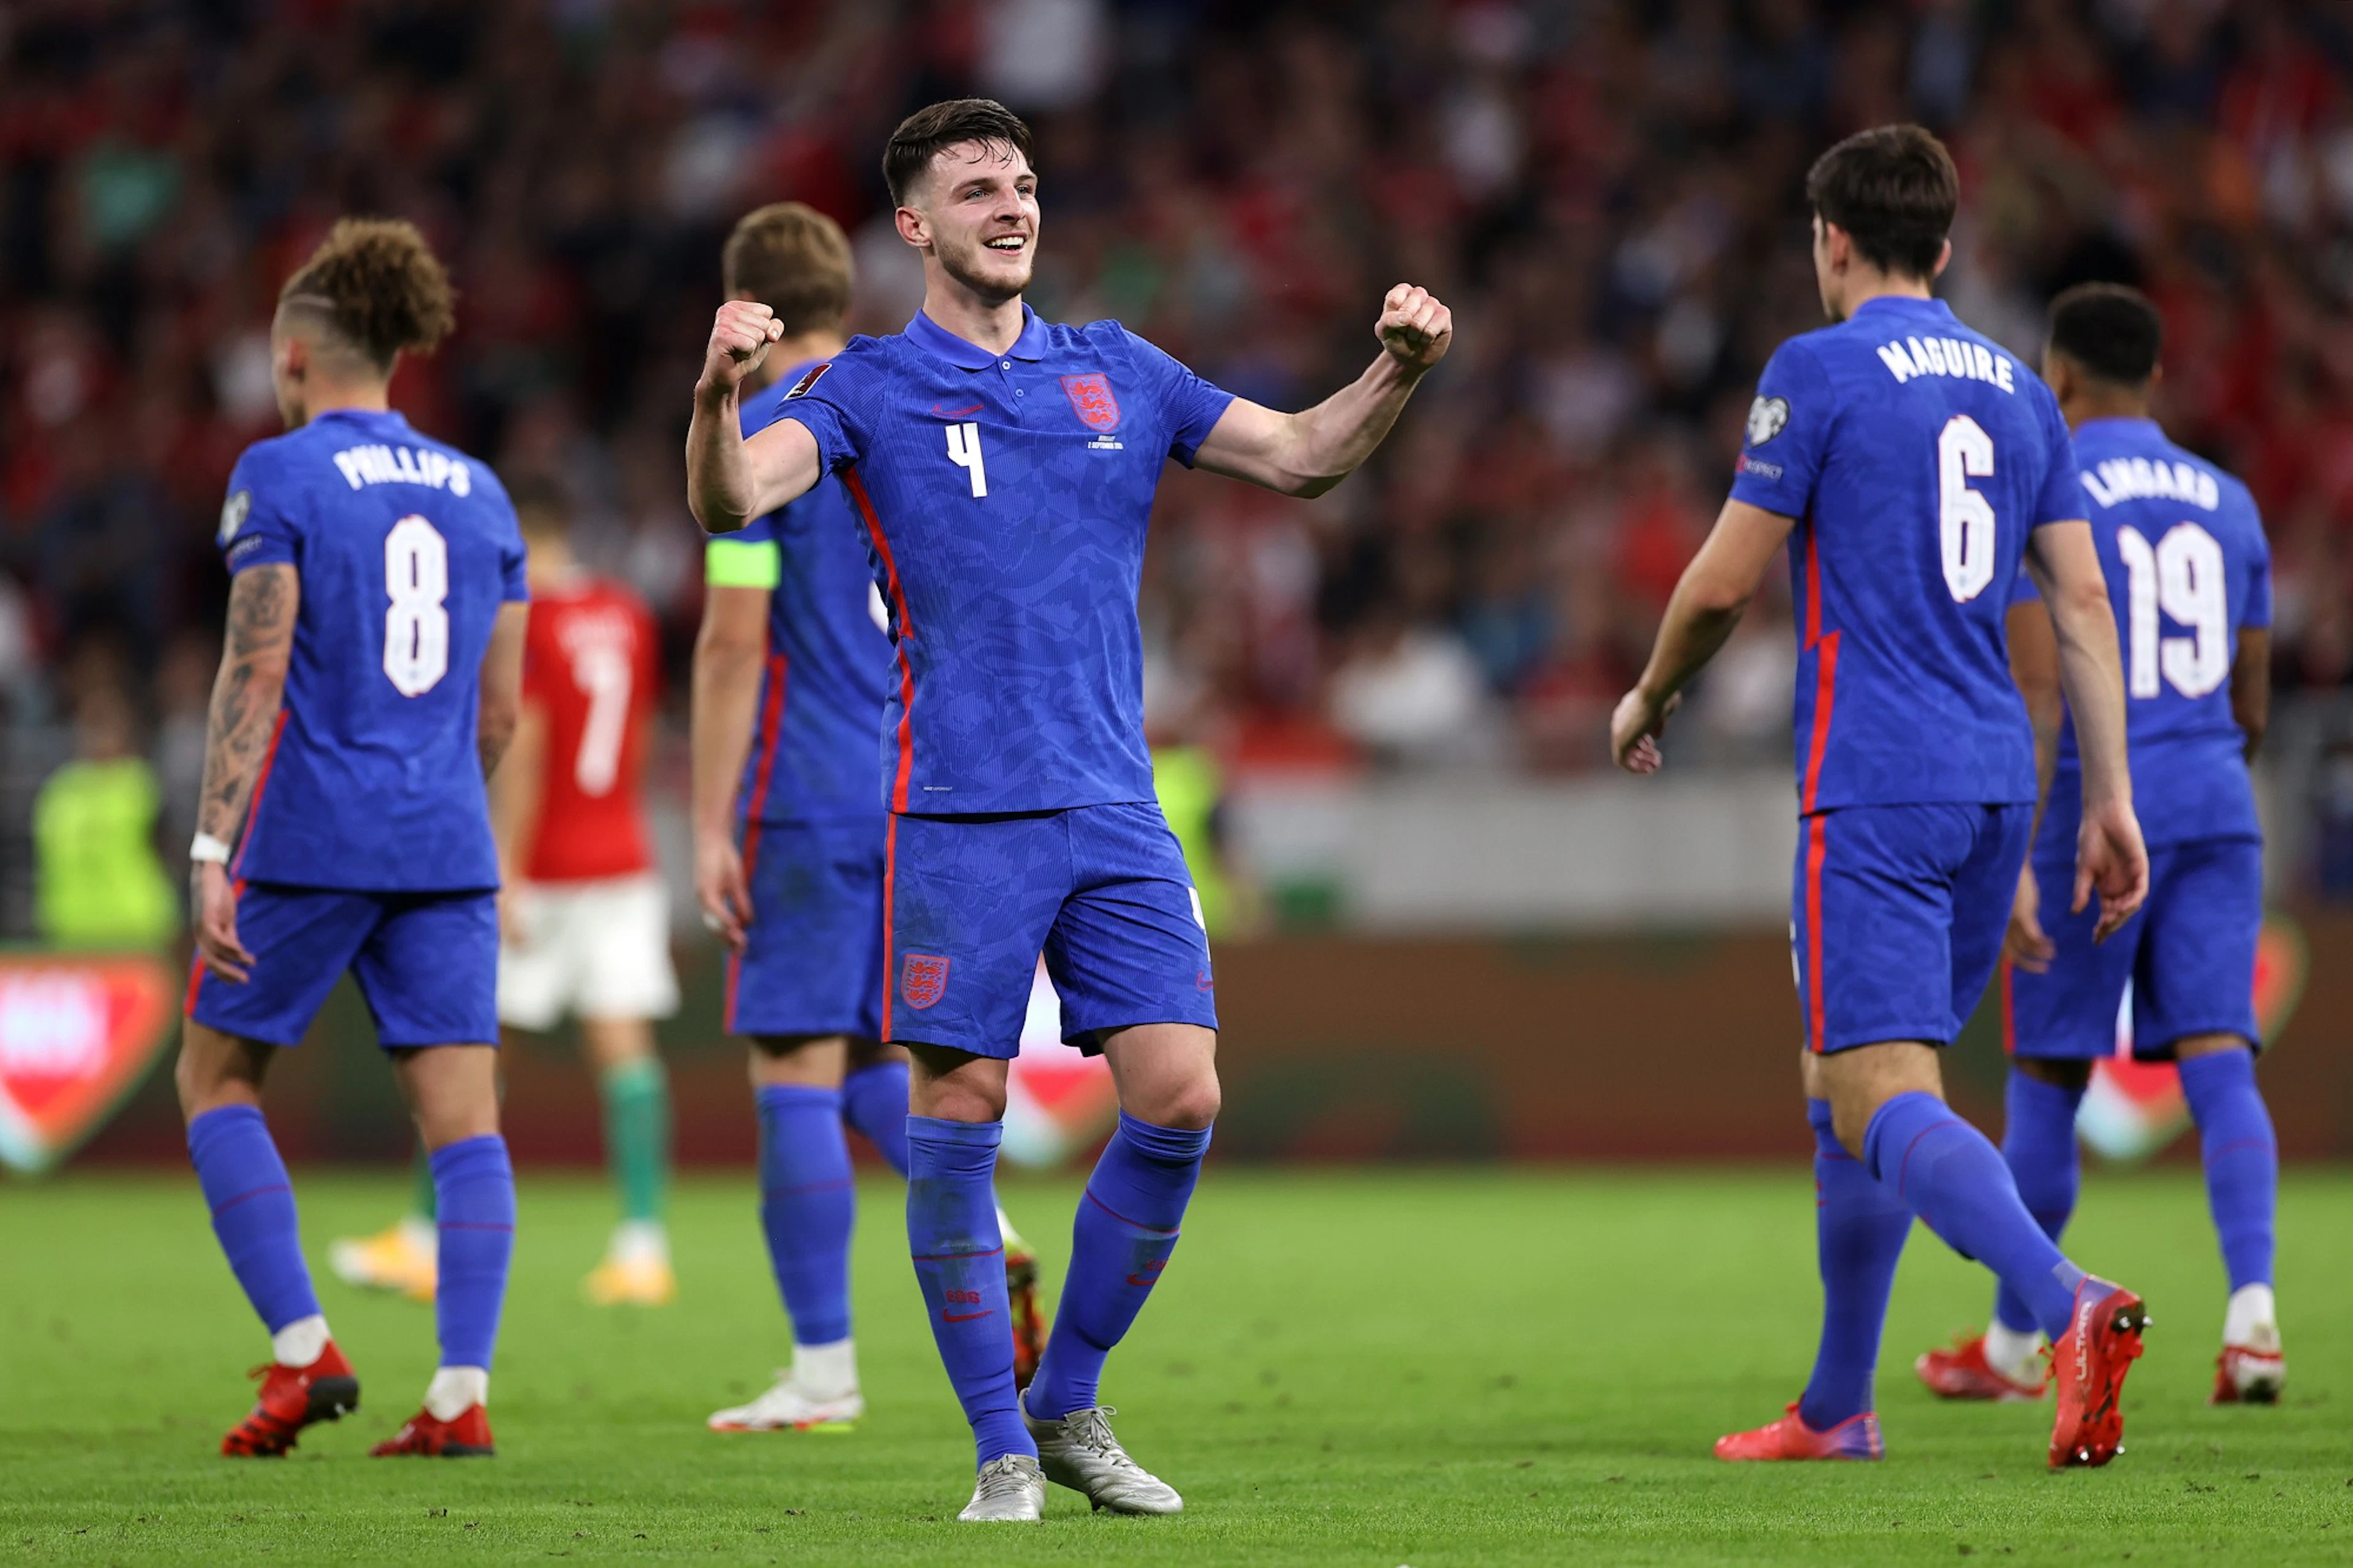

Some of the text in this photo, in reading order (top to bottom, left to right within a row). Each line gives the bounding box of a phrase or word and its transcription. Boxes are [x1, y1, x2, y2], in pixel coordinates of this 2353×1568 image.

[1877, 336, 2014, 394] MAGUIRE
[333, 445, 471, 497] PHILLIPS
[945, 423, 987, 498] 4
[2080, 457, 2219, 510] LINGARD
[1939, 415, 1995, 603] 6
[384, 515, 448, 697] 8
[2114, 522, 2229, 700] 19
